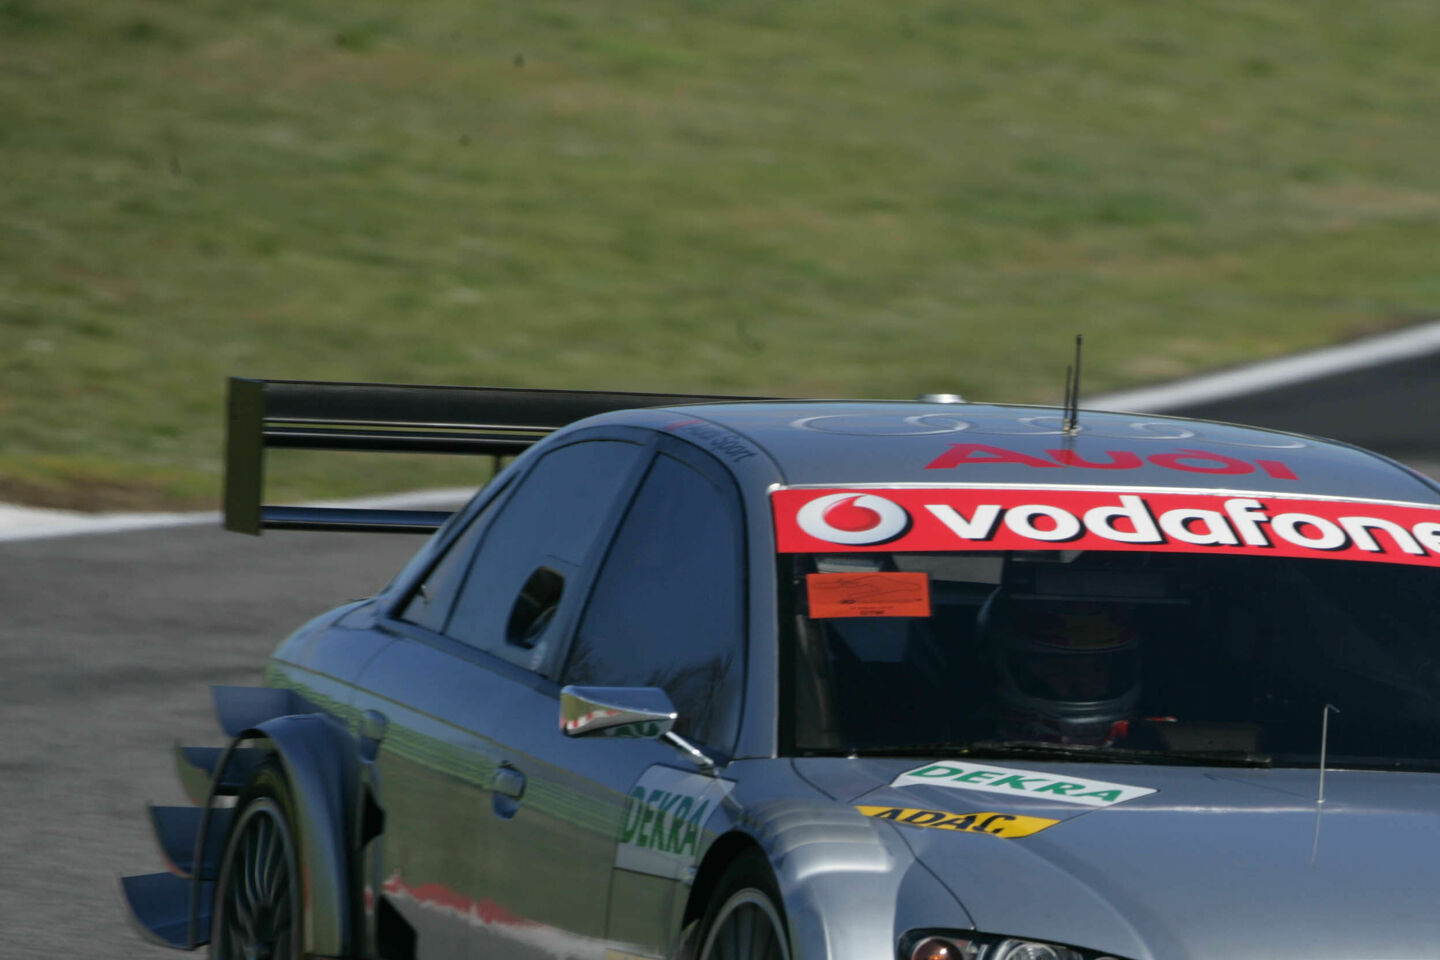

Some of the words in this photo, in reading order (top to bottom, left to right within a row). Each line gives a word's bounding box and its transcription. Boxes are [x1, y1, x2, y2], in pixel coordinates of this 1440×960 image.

[907, 765, 1124, 802] DEKRA
[620, 786, 711, 856] DEKRA
[873, 809, 1017, 835] ADAC
